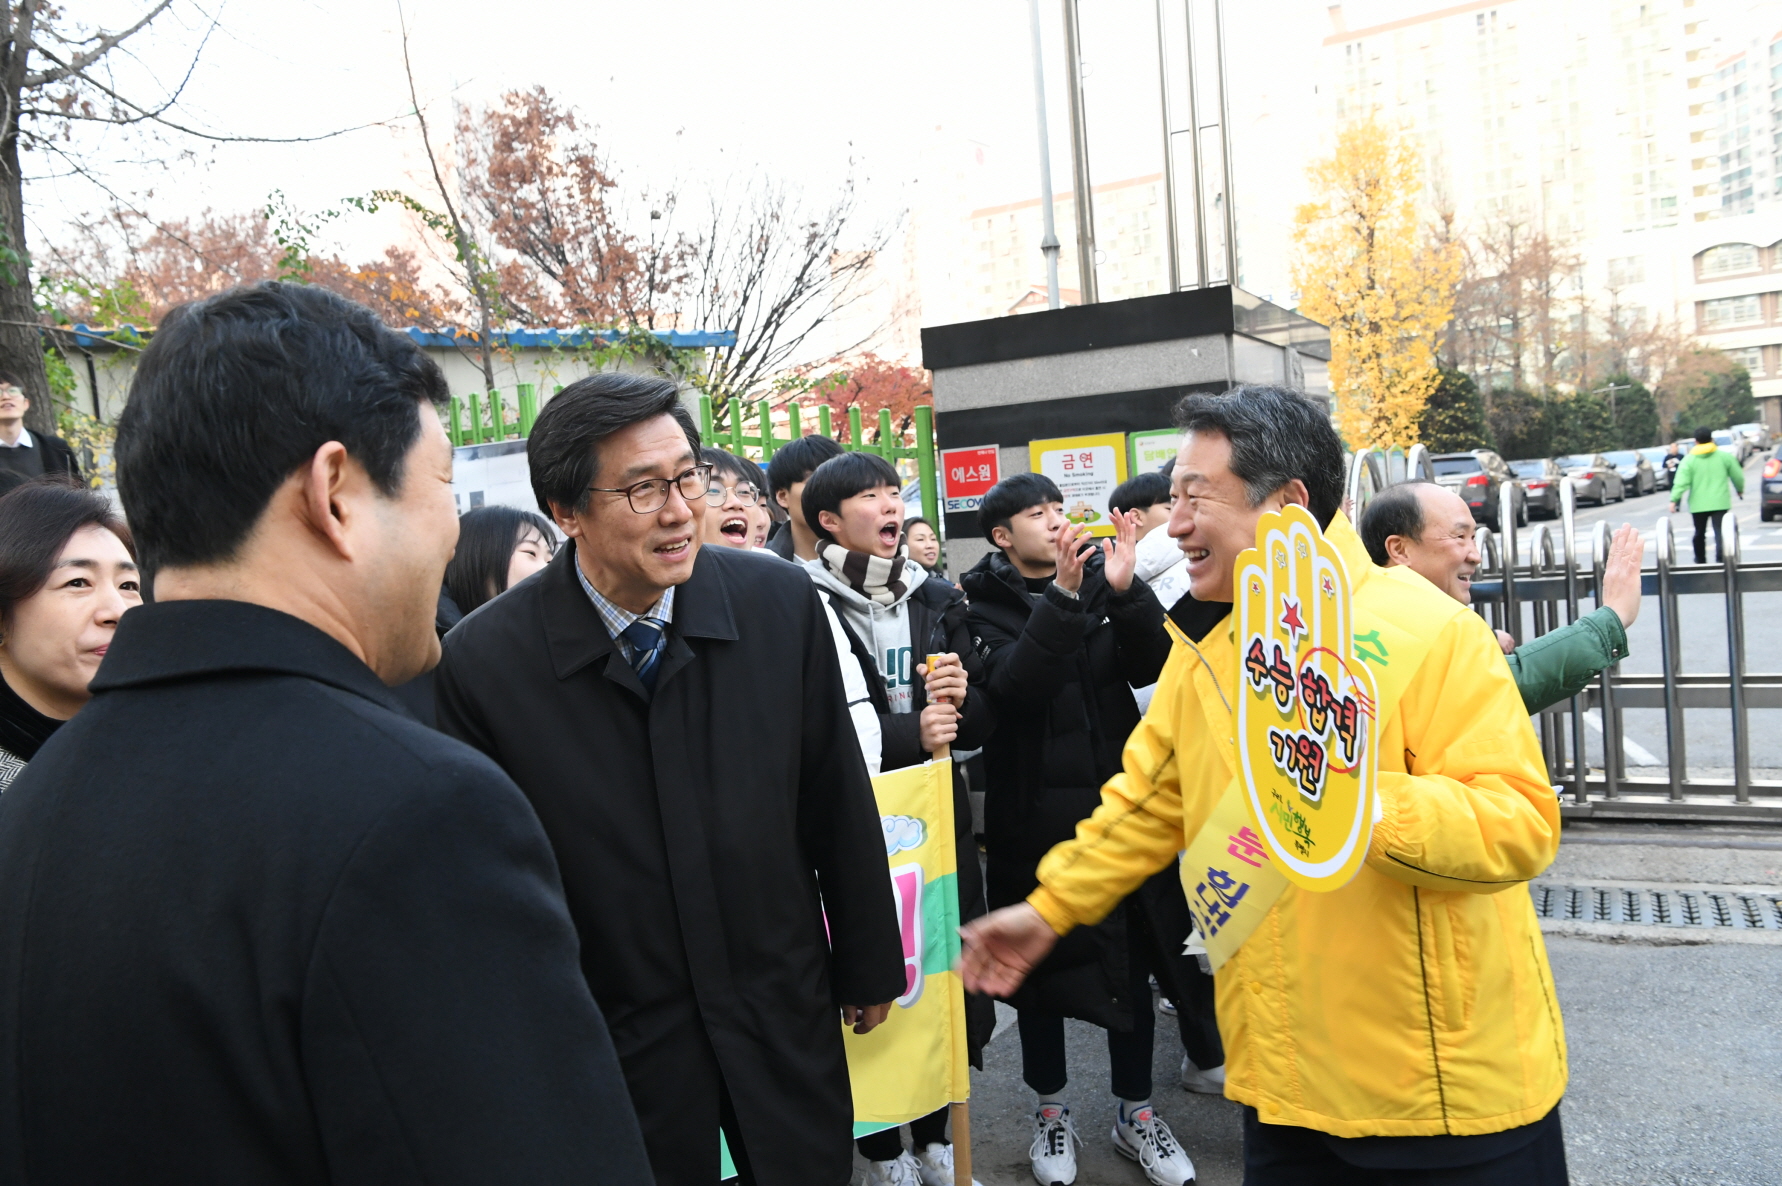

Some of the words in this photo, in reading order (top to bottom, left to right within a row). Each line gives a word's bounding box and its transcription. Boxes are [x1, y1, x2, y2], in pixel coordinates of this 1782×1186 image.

[951, 463, 991, 484] 에스원
[1245, 637, 1295, 708] 수능
[1300, 666, 1358, 763] 합격
[1270, 730, 1324, 797] 기원
